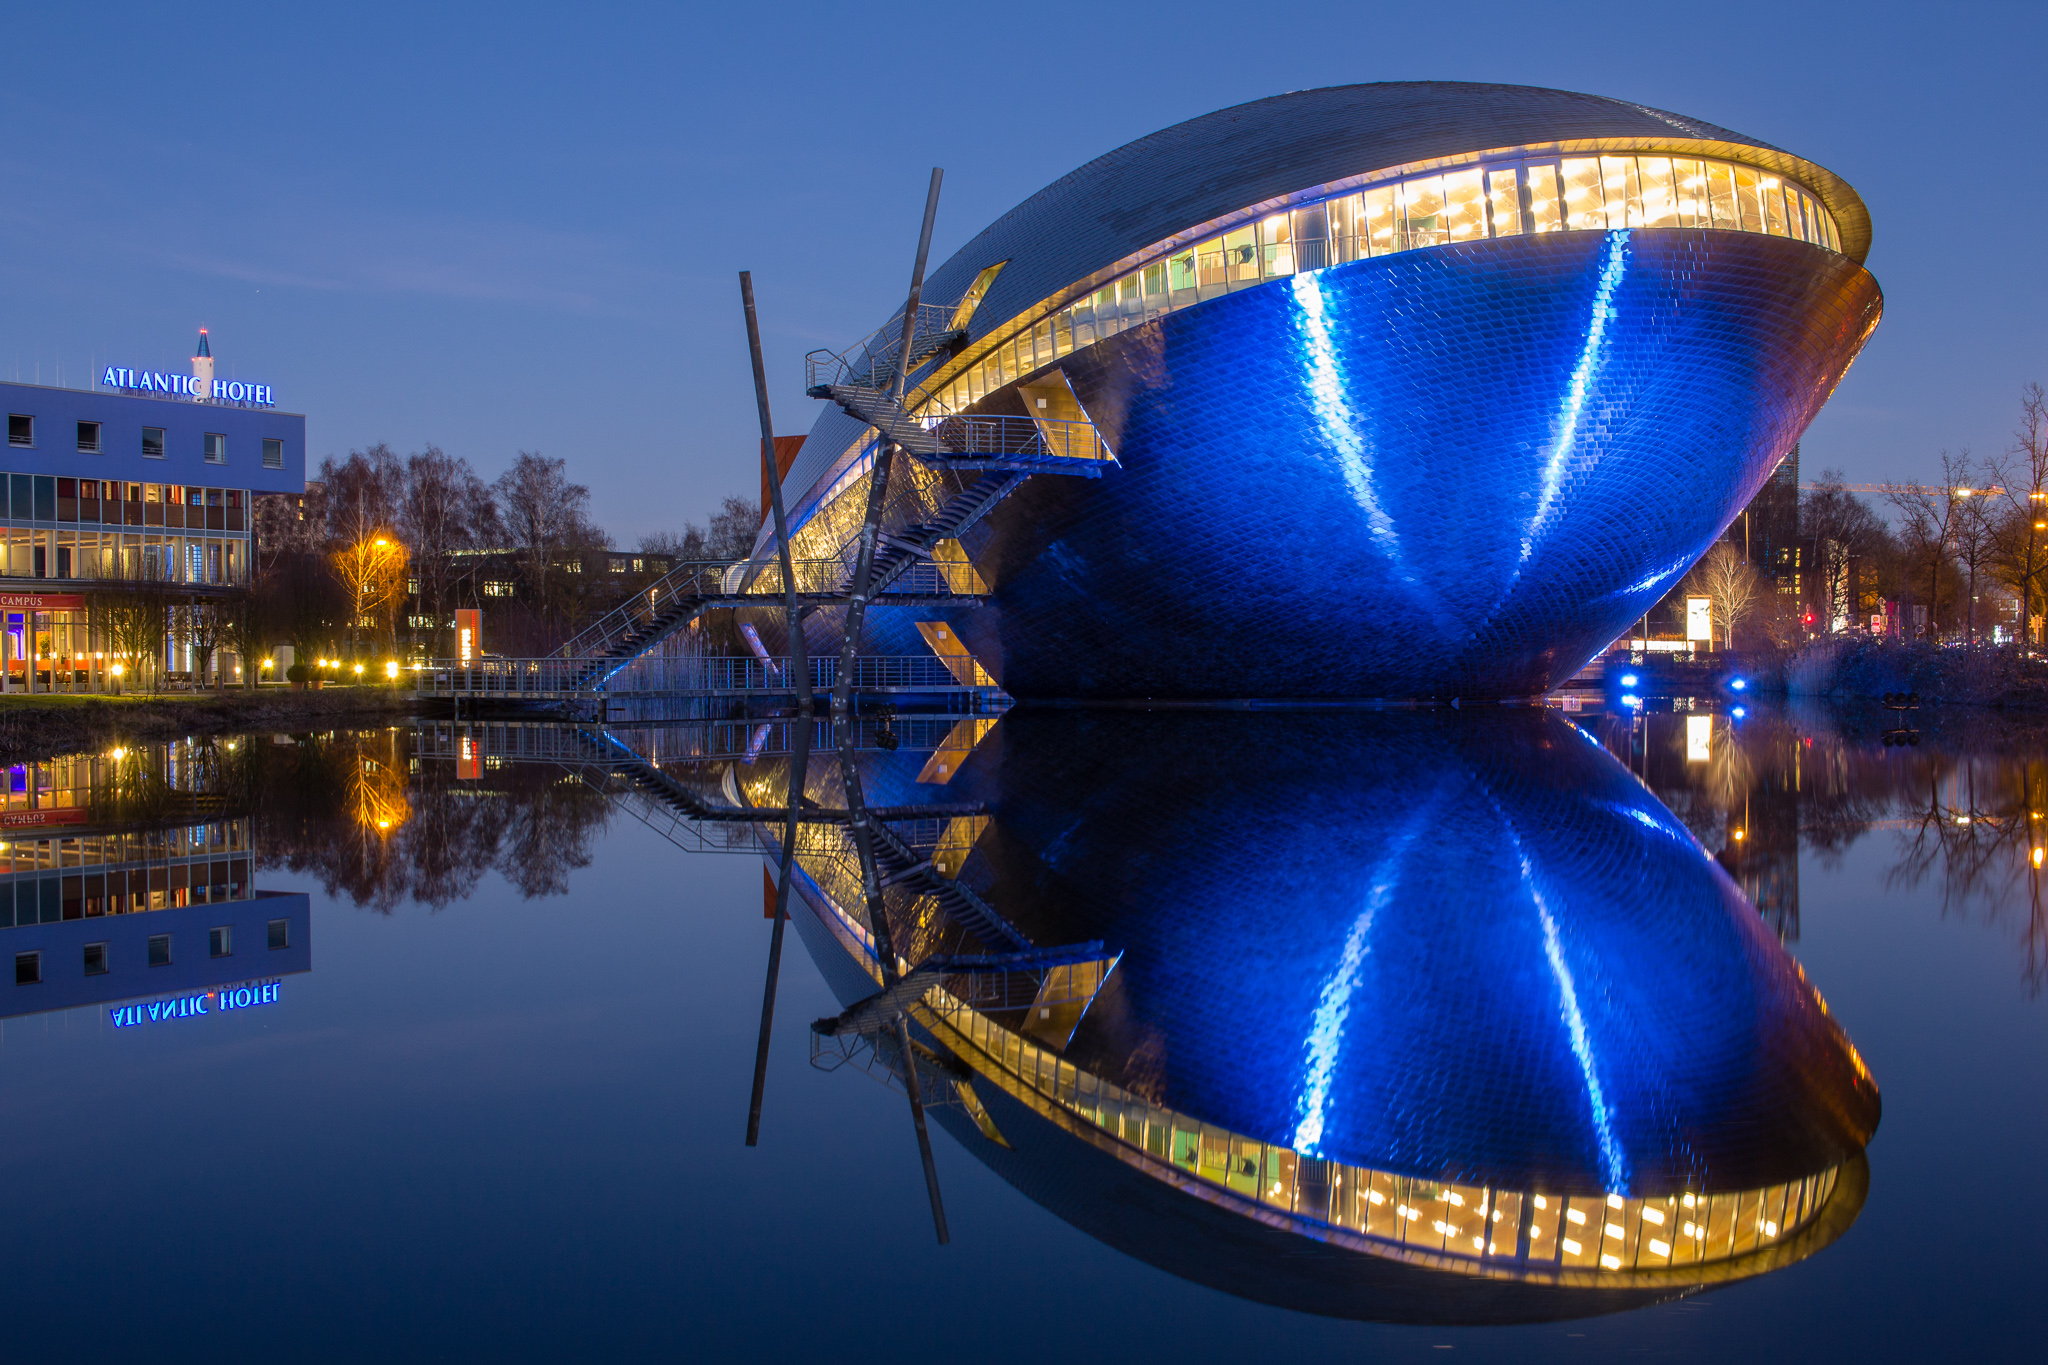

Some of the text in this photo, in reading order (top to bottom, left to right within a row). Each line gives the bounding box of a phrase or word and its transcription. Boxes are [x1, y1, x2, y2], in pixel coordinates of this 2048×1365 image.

[102, 366, 275, 404] ATLANTIC HOTEL
[1, 596, 43, 606] CAMPUS
